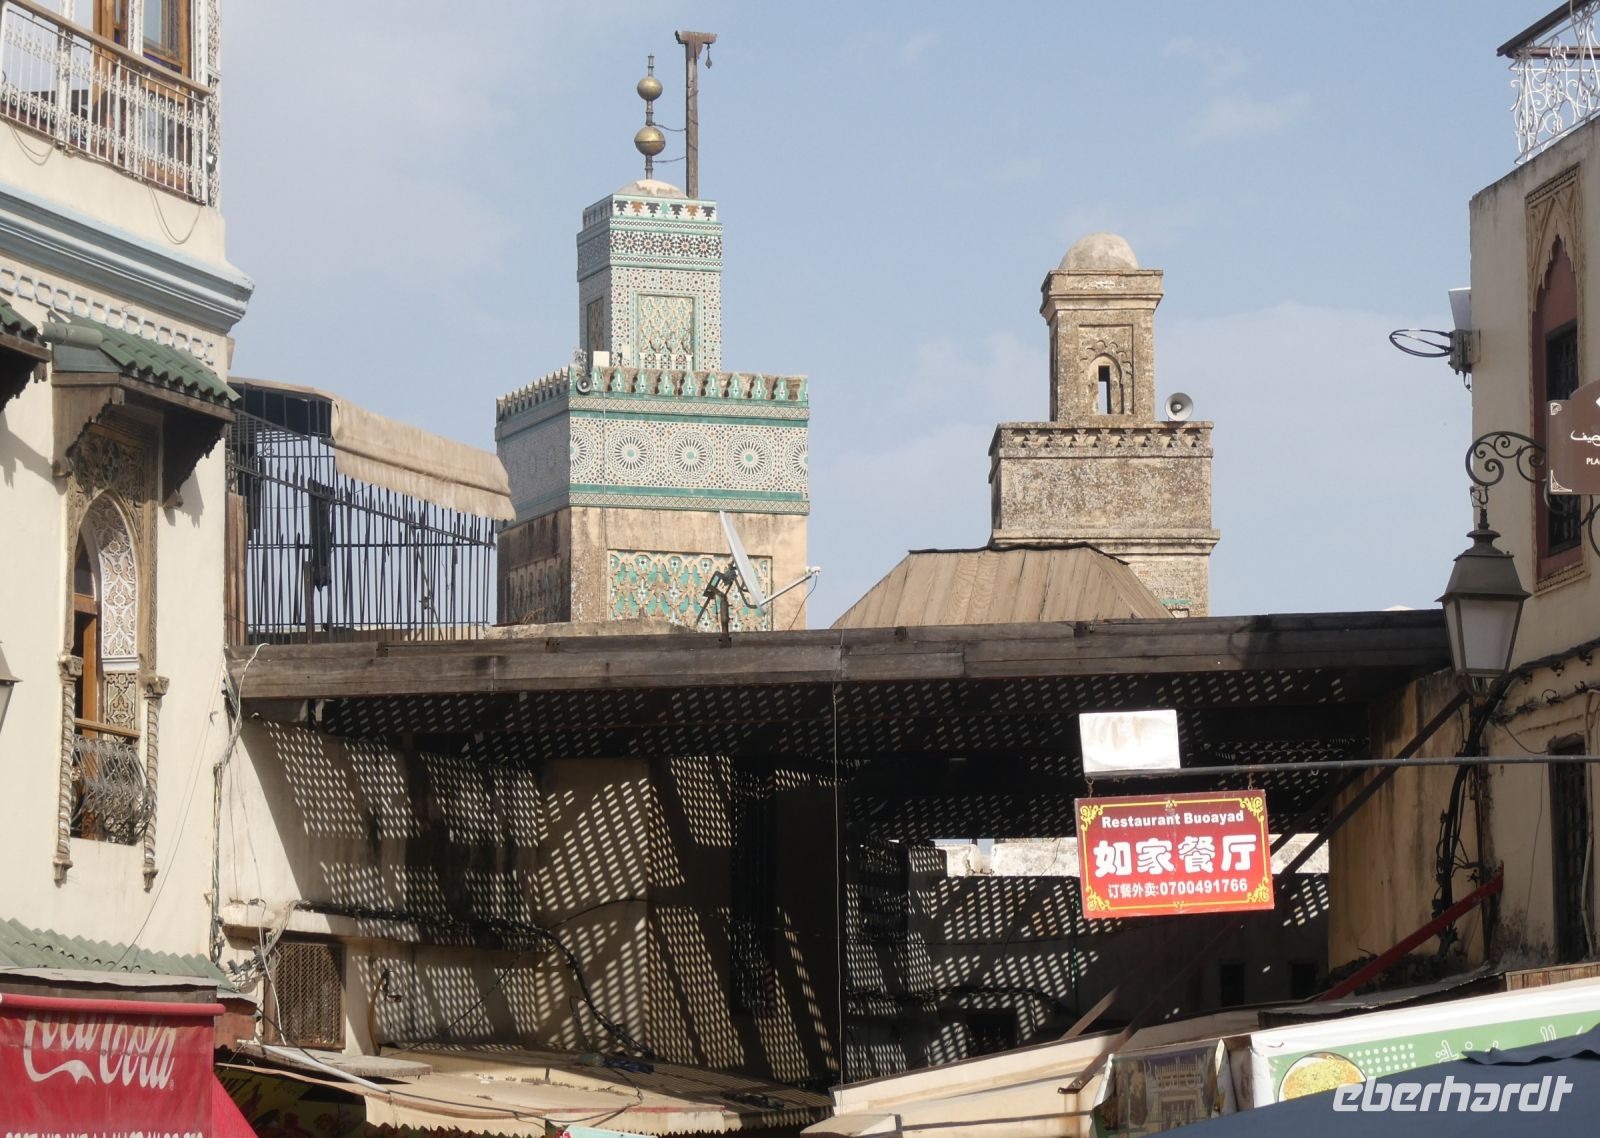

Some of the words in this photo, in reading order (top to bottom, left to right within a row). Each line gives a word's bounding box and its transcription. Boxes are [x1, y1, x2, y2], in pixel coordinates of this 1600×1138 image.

[1586, 457, 1600, 465] PLA
[1101, 813, 1181, 829] Restaurant
[1184, 810, 1245, 826] Buoayad
[1093, 834, 1258, 878] 如家餐厅
